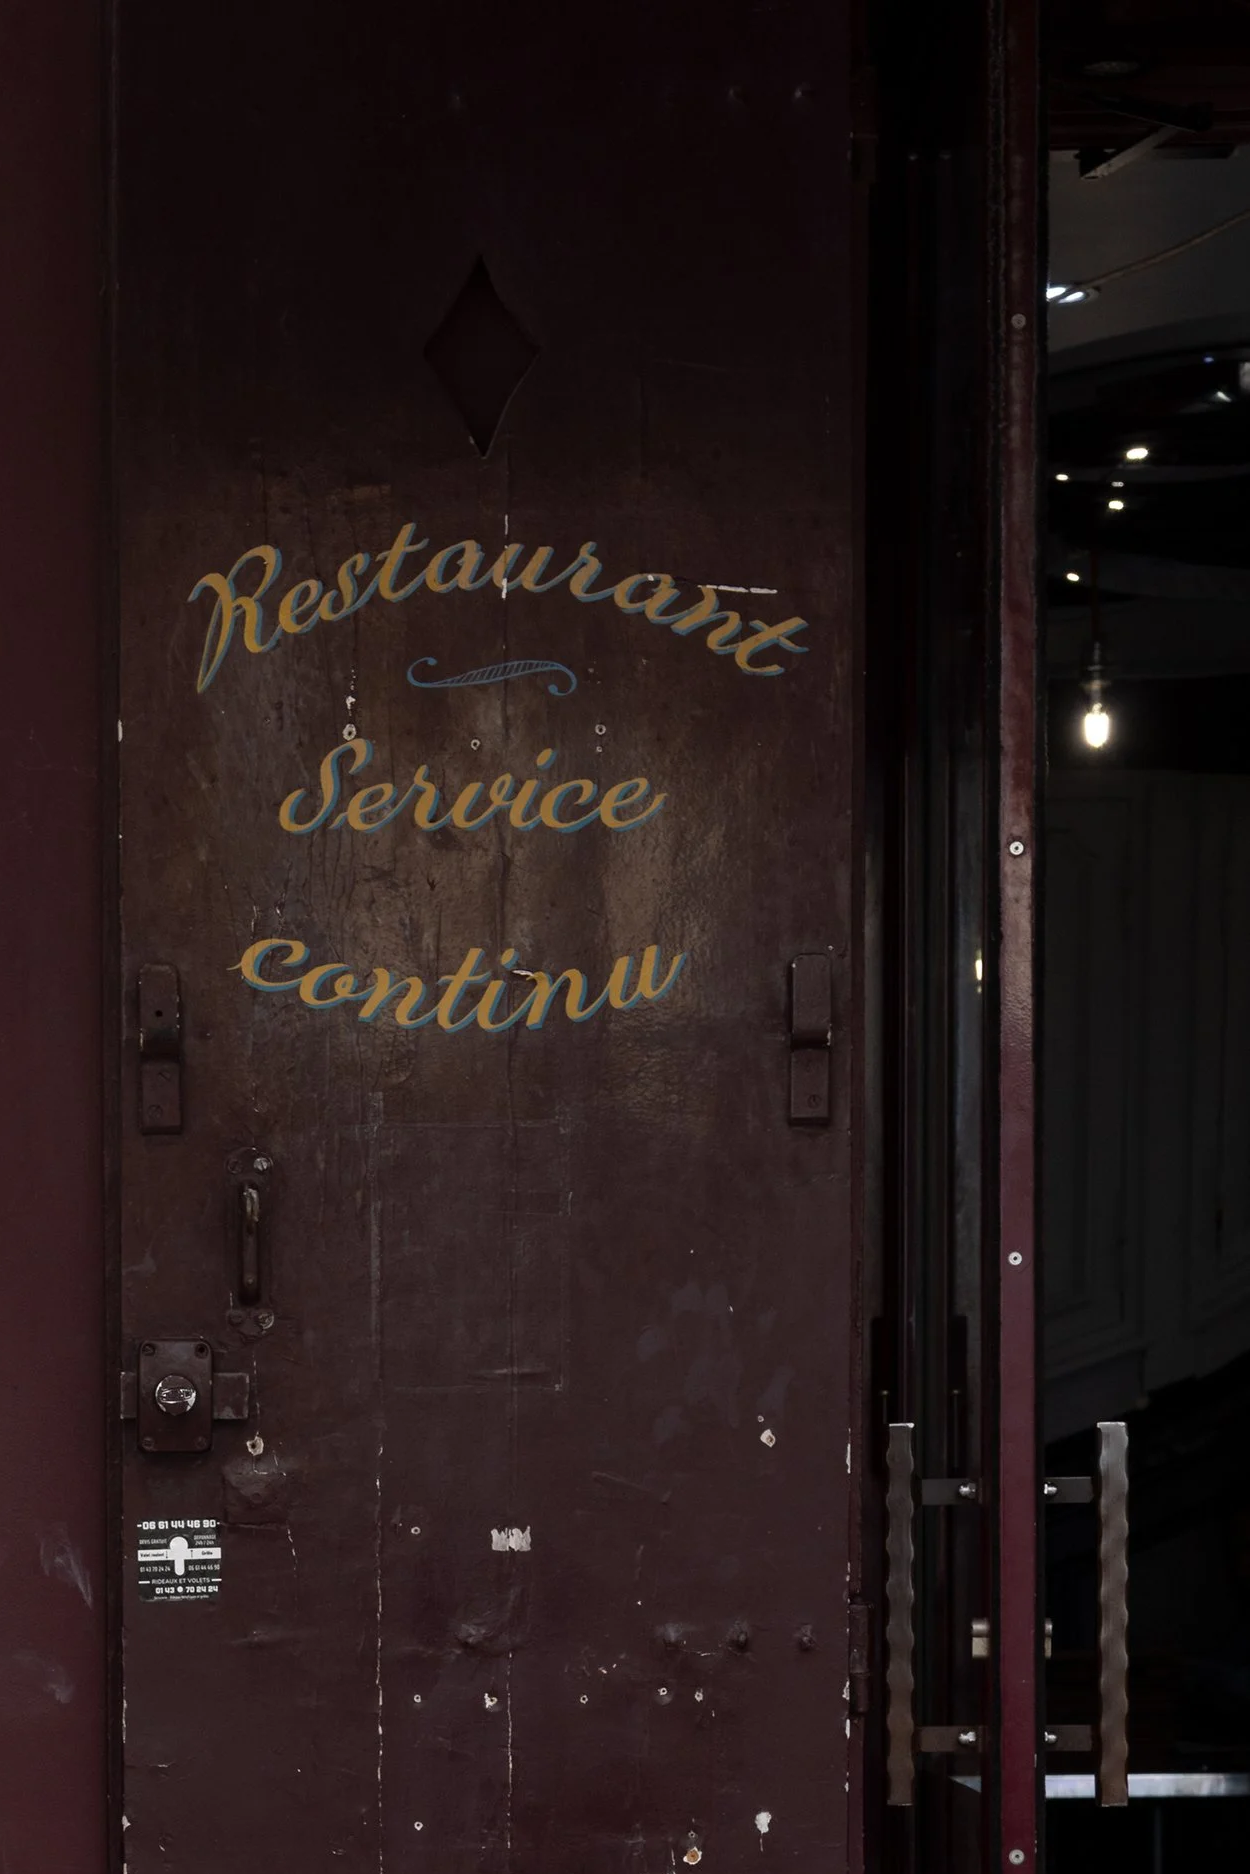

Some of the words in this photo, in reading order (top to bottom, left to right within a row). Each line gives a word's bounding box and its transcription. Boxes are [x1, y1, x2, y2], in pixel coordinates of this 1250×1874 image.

[187, 522, 810, 694] Restaurant
[278, 738, 668, 834] Service
[227, 937, 687, 1034] Continu
